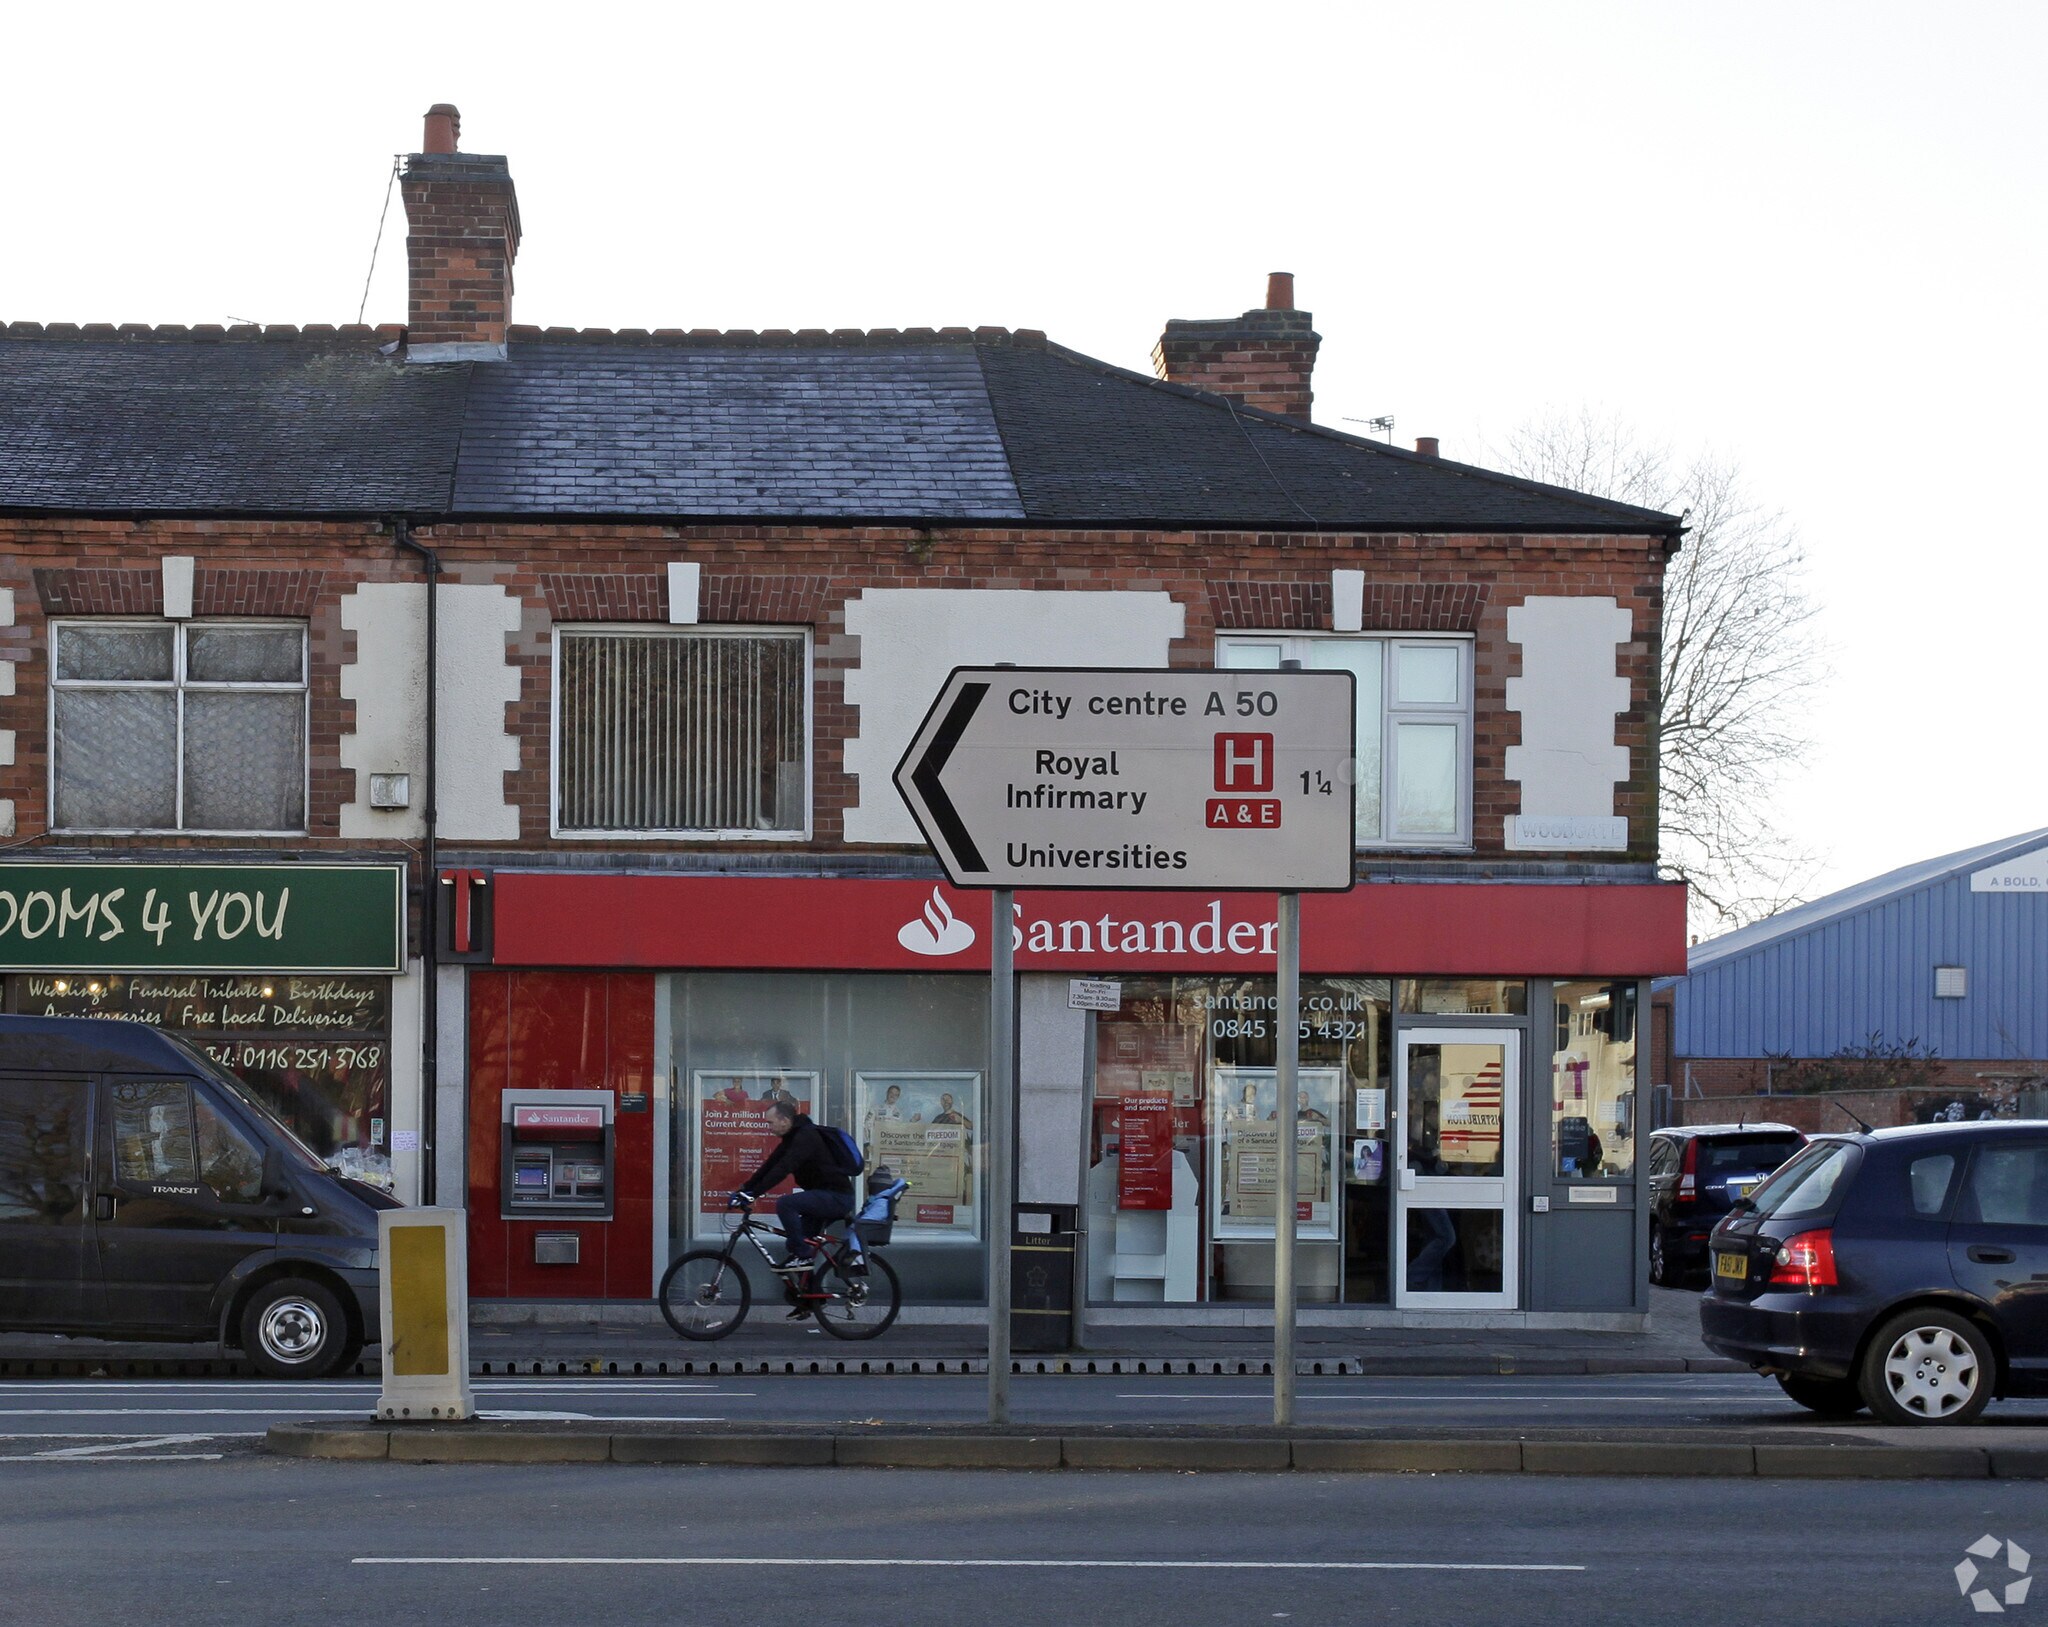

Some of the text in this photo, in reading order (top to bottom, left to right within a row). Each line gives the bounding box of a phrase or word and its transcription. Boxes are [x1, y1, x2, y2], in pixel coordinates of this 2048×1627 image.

[1008, 689, 1278, 720] City centre A 50
[1035, 749, 1119, 780] Royal
[1225, 739, 1262, 785] H
[1007, 784, 1147, 814] Infirmary
[1212, 805, 1275, 823] A & E
[1007, 843, 1188, 870] Universities
[1990, 877, 2041, 887] A BOLD,
[142, 888, 172, 946] 4
[189, 887, 289, 941] YOU
[129, 978, 197, 999] Funeral
[289, 976, 375, 1007] Birthdays
[1090, 982, 1111, 990] loading
[183, 1005, 216, 1025] Free
[222, 1004, 266, 1025] Local
[273, 1005, 353, 1026] Deliveries
[1213, 1019, 1266, 1039] 0845
[1318, 1021, 1366, 1040] 4321
[243, 1047, 288, 1070] 0116
[295, 1047, 328, 1070] 251
[335, 1047, 380, 1070] 3768
[1139, 1097, 1168, 1105] products
[542, 1114, 590, 1124] Santander
[705, 1110, 722, 1119] Join
[724, 1111, 729, 1119] 2
[732, 1111, 760, 1119] million
[705, 1120, 771, 1129] Current Accoun
[880, 1131, 959, 1140] Discover the FREEDOM
[151, 1186, 200, 1194] TRANSIT
[1025, 1236, 1051, 1245] Litter
